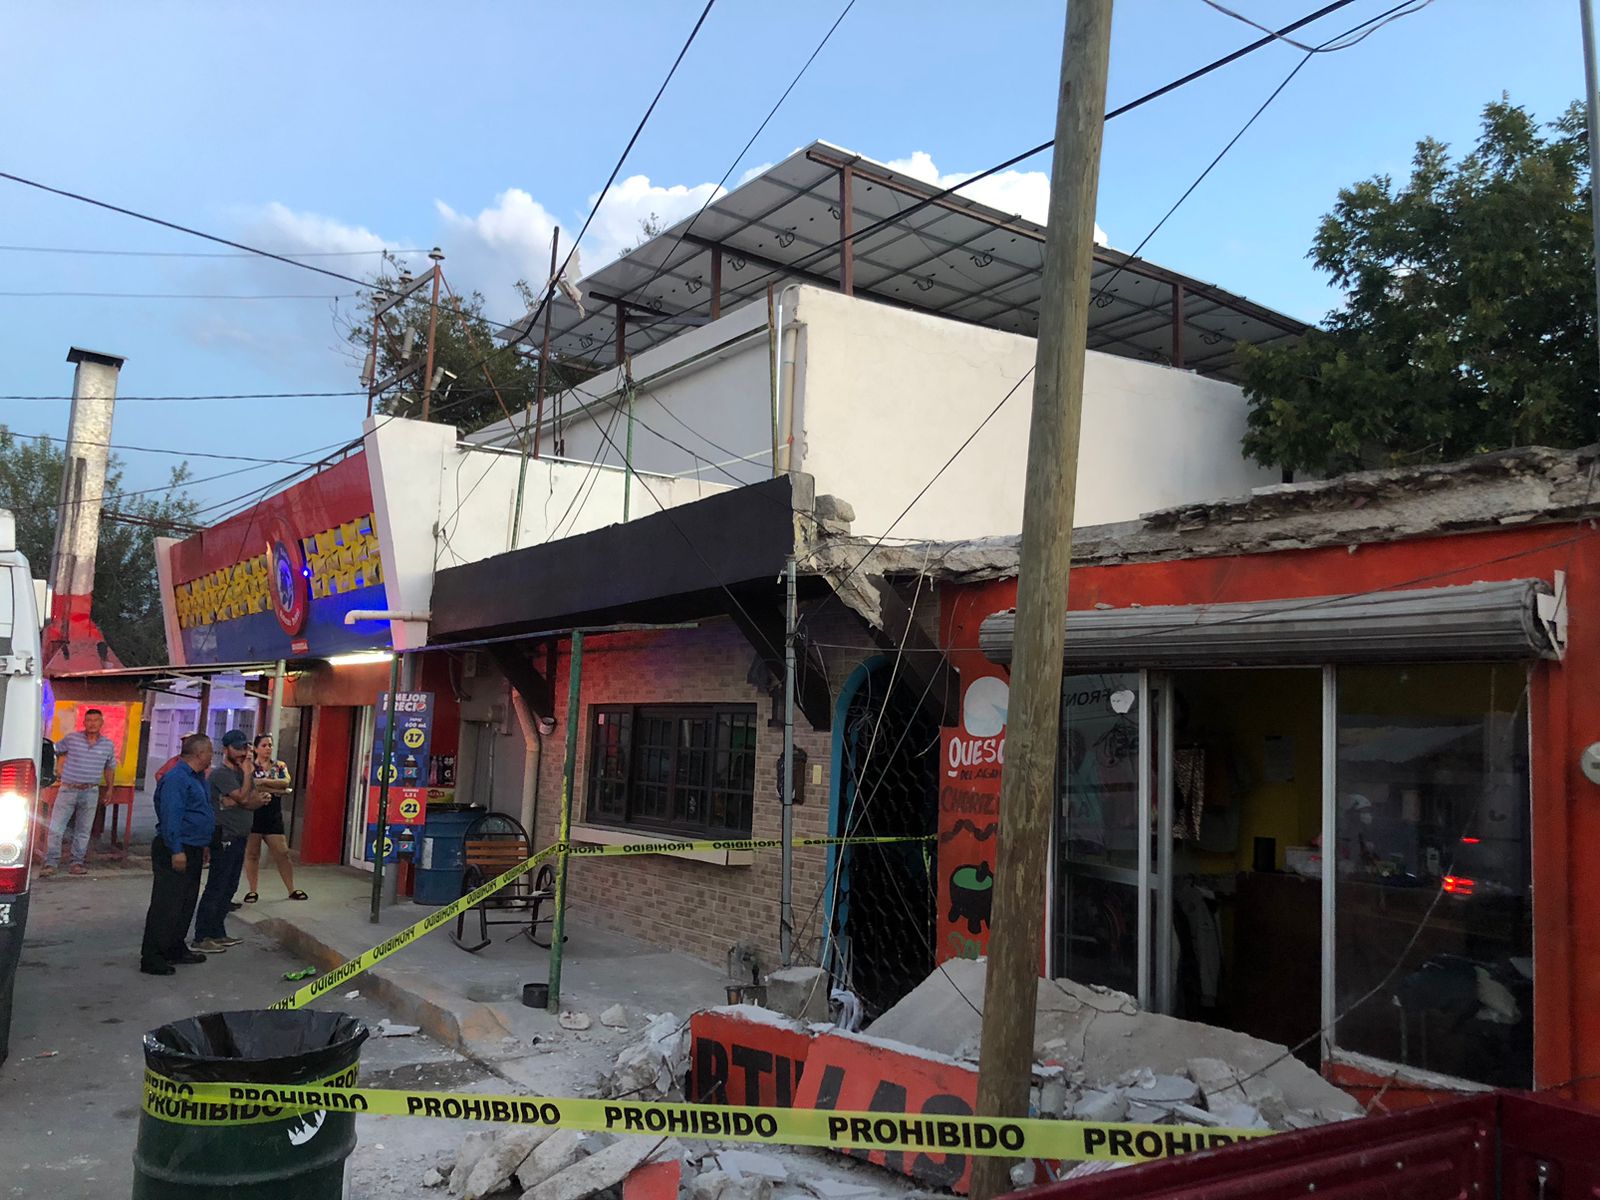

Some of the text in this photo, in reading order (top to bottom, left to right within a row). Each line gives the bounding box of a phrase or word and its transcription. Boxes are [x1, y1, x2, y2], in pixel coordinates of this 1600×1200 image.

[941, 784, 1000, 815] CHORIZ
[229, 1087, 369, 1111] PROHIBIDO
[406, 1095, 561, 1126] PROHIBIDO
[604, 1105, 778, 1138] PROHIBIDO
[828, 1116, 1025, 1152] PROHIBIDO
